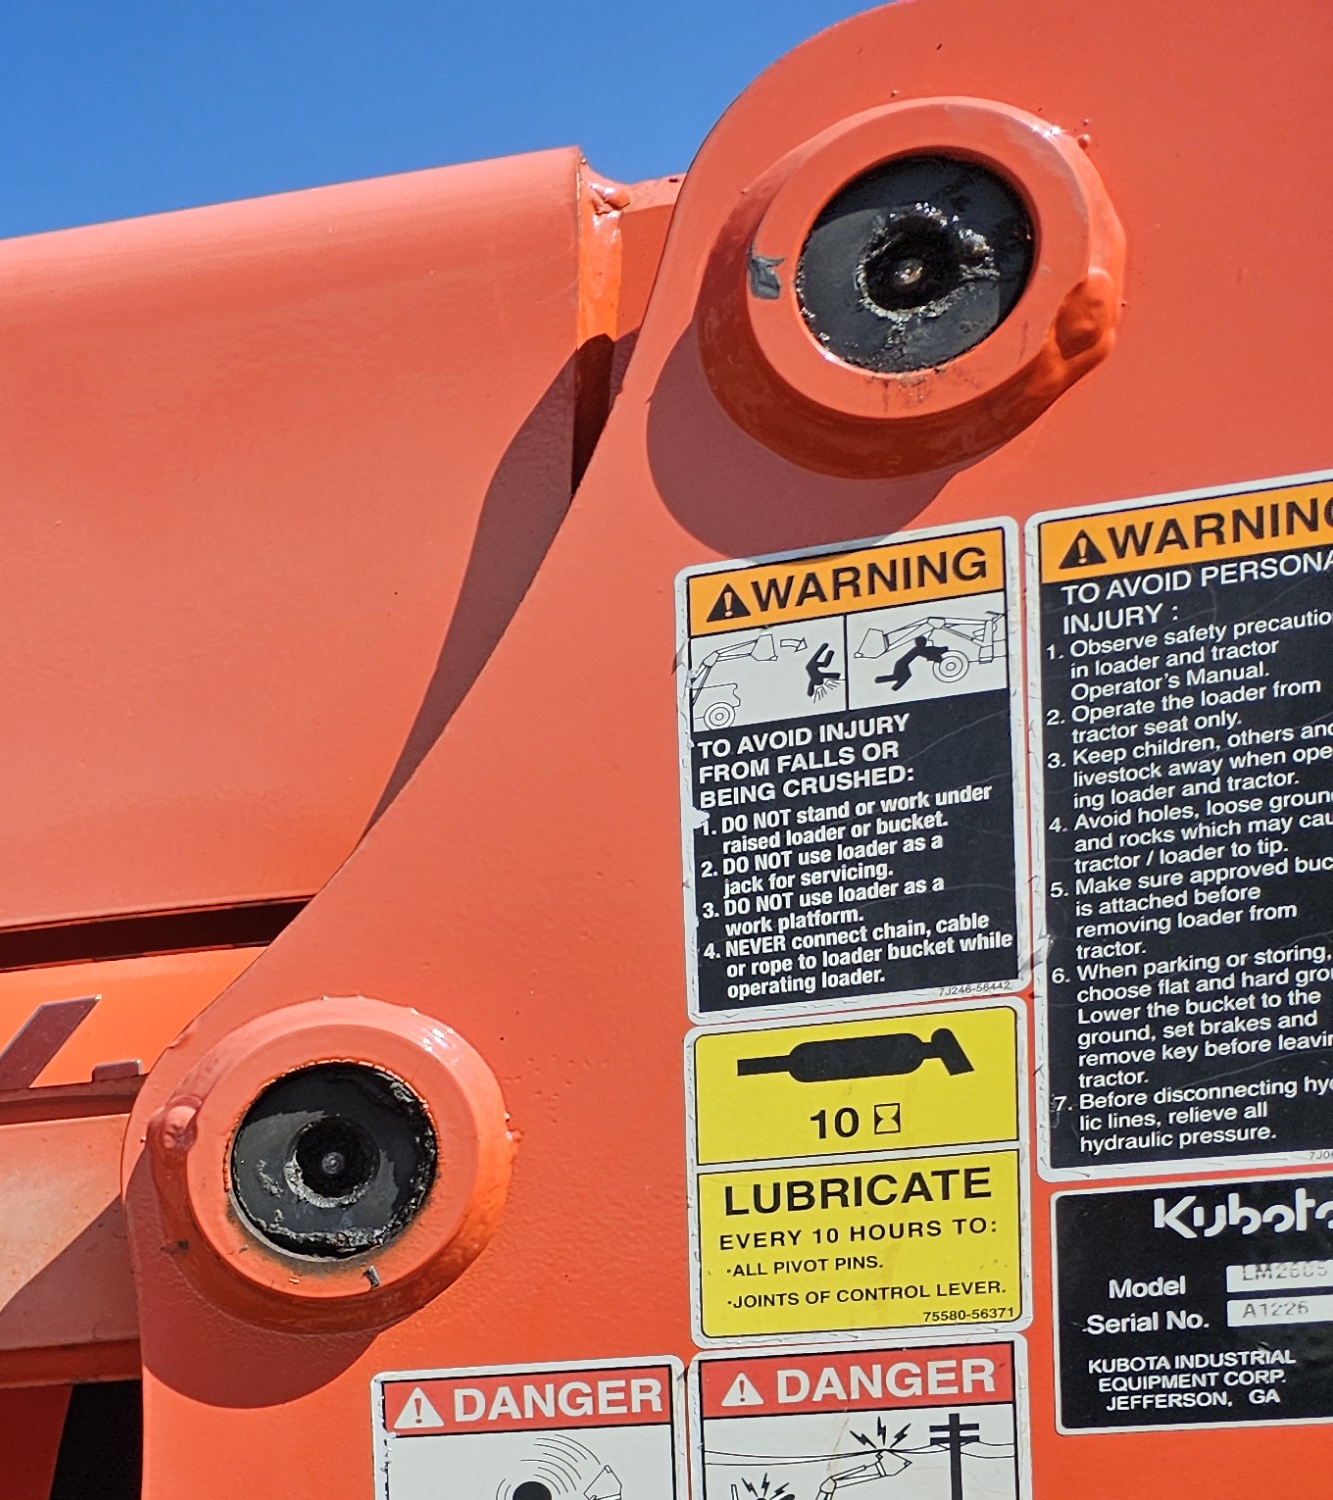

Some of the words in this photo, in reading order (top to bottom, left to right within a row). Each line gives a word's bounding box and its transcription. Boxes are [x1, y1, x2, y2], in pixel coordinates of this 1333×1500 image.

[751, 547, 986, 612] WARNING
[1061, 583, 1099, 605] TO
[1106, 570, 1191, 600] AVOID
[1064, 603, 1163, 634] INJURY
[1071, 635, 1157, 657] Observe
[1164, 624, 1227, 645] safety
[1071, 663, 1088, 678] in
[1096, 655, 1159, 675] loader
[1166, 646, 1204, 667] and
[1211, 640, 1279, 661] tractor
[1187, 661, 1269, 686] Manual.
[1047, 710, 1065, 725] 2.
[1072, 699, 1155, 724] Operate
[1161, 694, 1194, 711] the
[1201, 686, 1266, 706] loader
[1273, 680, 1321, 697] from
[697, 739, 730, 758] TO
[737, 728, 812, 754] AVOID
[820, 713, 909, 742] INJURY
[1072, 724, 1138, 743] tractor
[1144, 716, 1188, 735] seat
[1195, 710, 1241, 729] only.
[700, 758, 769, 783] FROM
[778, 747, 855, 773] FALLS
[863, 741, 898, 761] OR
[701, 783, 775, 808] BEING
[783, 766, 913, 797] CRUSHED:
[722, 815, 747, 833] DO
[754, 809, 791, 829] NOT
[797, 801, 849, 824] stand
[856, 801, 875, 816] or
[880, 791, 930, 812] work
[936, 785, 992, 806] under
[723, 832, 780, 854] raised
[787, 825, 846, 846] loader
[851, 823, 871, 837] or
[877, 811, 948, 834] bucket.
[701, 861, 717, 877] 2.
[723, 856, 749, 874] DO
[755, 850, 792, 870] NOT
[799, 849, 831, 865] use
[838, 840, 897, 860] loader
[903, 838, 925, 852] as
[931, 835, 943, 849] a
[723, 876, 763, 899] jack
[769, 873, 795, 890] for
[801, 862, 893, 886] servicing.
[703, 902, 719, 918] 3.
[725, 898, 750, 916] DO
[757, 892, 793, 912] NOT
[800, 891, 832, 907] use
[839, 882, 899, 902] loader
[904, 880, 926, 894] as
[932, 878, 944, 891] a
[704, 943, 720, 959] 4.
[726, 935, 785, 957] NEVER
[792, 926, 867, 949] connect
[873, 920, 931, 940] chain,
[936, 913, 989, 933] cable
[725, 916, 772, 936] work
[778, 909, 863, 933] platform.
[727, 964, 746, 977] or
[752, 959, 792, 976] rope
[798, 954, 816, 969] to
[823, 947, 882, 967] loader
[888, 937, 955, 960] bucket
[959, 932, 1013, 951] while
[728, 975, 815, 1000] operating
[822, 968, 885, 988] loader.
[811, 1108, 859, 1139] 10
[1081, 1132, 1173, 1155] hydraulic
[1180, 1127, 1276, 1149] pressure.
[725, 1167, 991, 1216] LUBRICATE
[720, 1230, 801, 1250] EVERY
[813, 1228, 838, 1243] 10
[851, 1221, 941, 1241] HOURS
[953, 1218, 996, 1234] TO:
[774, 1259, 828, 1274] PIVOT
[836, 1256, 883, 1270] PINS.
[806, 1291, 830, 1304] OF
[837, 1285, 930, 1302] CONTROL
[937, 1281, 1005, 1296] LEVER.
[1109, 1276, 1185, 1298] Model
[923, 1307, 1013, 1322] 75580-56371
[1087, 1312, 1158, 1334] Serial
[1167, 1310, 1209, 1329] No.
[1089, 1356, 1171, 1373] KUBOTA
[1175, 1348, 1296, 1368] INDUSTRIAL
[777, 1359, 995, 1403] DANGER
[1099, 1372, 1219, 1392] EQUIPMENT
[1224, 1370, 1286, 1386] CORP.
[454, 1378, 662, 1422] DANGER
[1107, 1392, 1232, 1411] JEFFERSON,
[1249, 1389, 1280, 1404] GA
